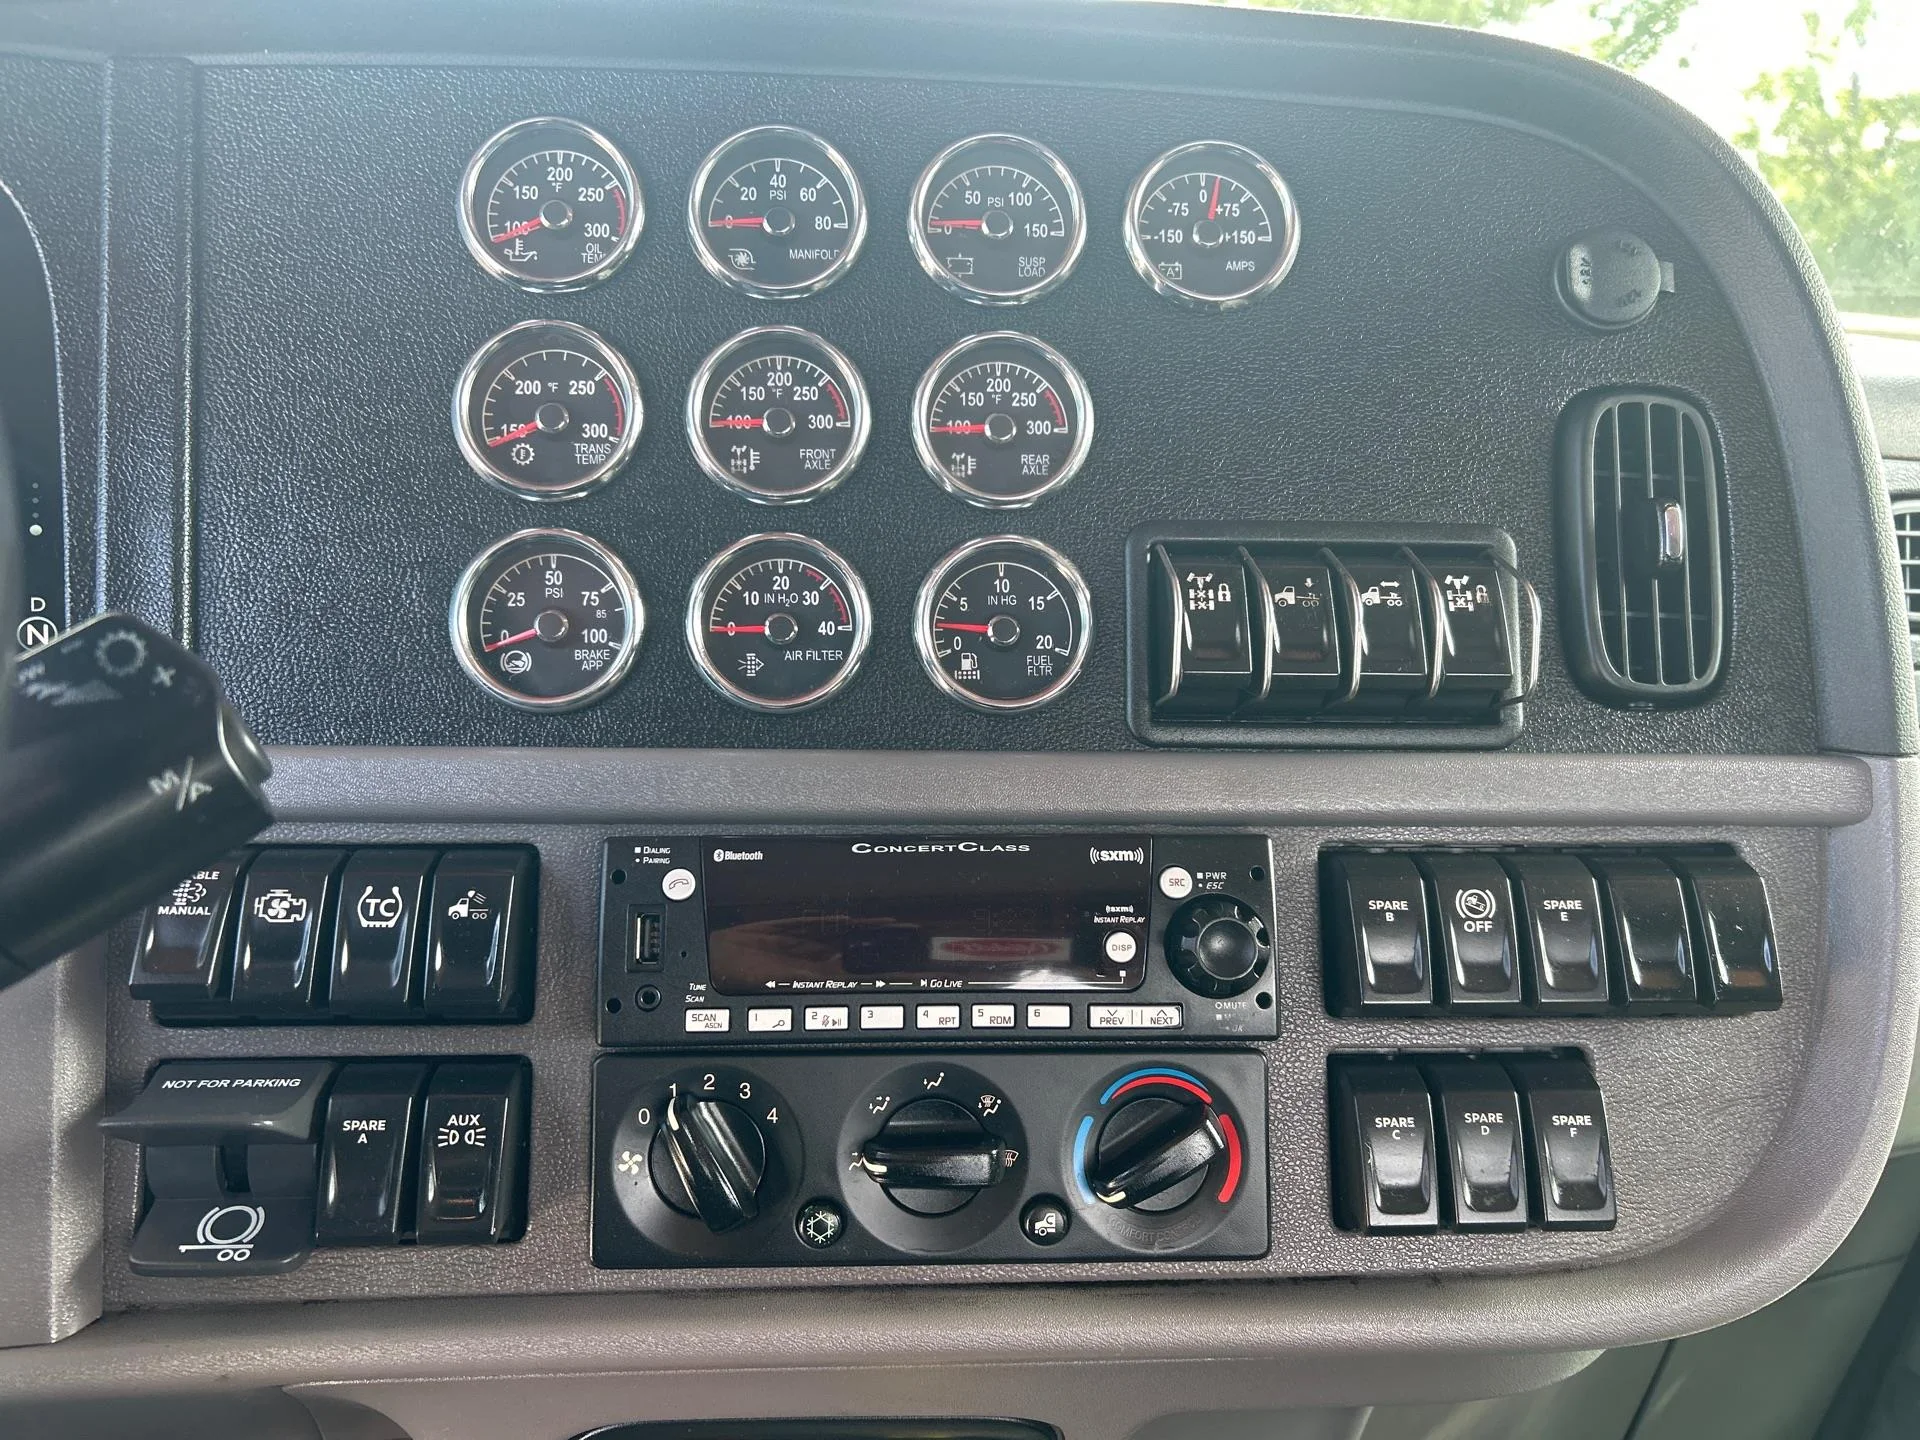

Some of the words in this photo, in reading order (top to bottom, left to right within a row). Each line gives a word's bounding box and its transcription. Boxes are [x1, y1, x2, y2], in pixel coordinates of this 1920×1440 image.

[547, 167, 573, 181] 200
[769, 174, 786, 188] 40
[513, 186, 539, 200] 150
[578, 187, 604, 202] 250
[740, 187, 757, 201] 20
[769, 190, 786, 201] PSI
[799, 187, 817, 202] 60
[964, 191, 981, 205] 50
[1008, 192, 1033, 207] 100
[1199, 189, 1207, 204] 0
[987, 197, 1004, 208] PSI
[1167, 202, 1189, 217] -75
[1216, 203, 1240, 218] +75
[725, 215, 733, 229] 0
[814, 216, 832, 231] 80
[584, 223, 610, 238] 300
[944, 223, 952, 236] 0
[1024, 223, 1049, 238] 150
[1153, 229, 1183, 244] -150
[1225, 230, 1256, 245] +150
[586, 243, 603, 254] OIL
[1018, 256, 1046, 268] SUSP
[1225, 260, 1256, 272] AMPS
[1018, 267, 1046, 278] LOAD
[766, 372, 793, 387] 200
[985, 378, 1012, 394] 200
[514, 380, 541, 396] 200
[569, 380, 596, 396] 250
[740, 386, 765, 402] 150
[793, 386, 819, 402] 250
[959, 392, 985, 408] 150
[1011, 392, 1038, 408] 250
[808, 414, 834, 430] 300
[1026, 420, 1052, 436] 300
[582, 424, 609, 439] 300
[574, 443, 612, 455] TRANS
[799, 449, 837, 461] FRONT
[575, 454, 606, 465] TEMP
[804, 459, 832, 471] AXLE
[1020, 454, 1051, 466] REAR
[1021, 465, 1049, 476] AXLE
[545, 571, 563, 586] 50
[772, 575, 790, 591] 20
[993, 578, 1010, 593] 10
[508, 592, 526, 607] 25
[545, 588, 563, 599] PSI
[580, 592, 600, 607] 75
[742, 590, 760, 606] 10
[764, 594, 775, 604] IN
[802, 590, 820, 606] 30
[987, 595, 998, 606] IN
[1001, 594, 1017, 606] HG
[30, 597, 46, 612] D
[960, 597, 968, 611] 5
[1028, 595, 1045, 611] 15
[596, 609, 607, 619] 85
[727, 621, 736, 636] 0
[818, 620, 836, 636] 40
[26, 623, 49, 647] N
[501, 629, 509, 643] 0
[582, 629, 609, 645] 100
[953, 636, 962, 650] 0
[1035, 635, 1053, 650] 20
[574, 650, 611, 661] BRAKE
[784, 650, 803, 661] AIR
[806, 650, 844, 661] FILTER
[1026, 656, 1053, 666] FUEL
[581, 660, 604, 671] APP
[1027, 666, 1052, 676] FLTR
[725, 851, 764, 862] Bluetooth
[1206, 871, 1228, 881] PWR
[1169, 878, 1186, 888] SRC
[1207, 881, 1225, 891] ESC
[158, 905, 211, 917] MANUAL
[365, 898, 396, 918] TC
[1368, 899, 1409, 911] SPARE
[1543, 899, 1583, 911] SPARE
[1385, 911, 1395, 922] B
[1560, 911, 1569, 921] E
[1463, 920, 1494, 933] OFF
[1112, 943, 1133, 952] DISP
[792, 980, 825, 989] INSTANT
[825, 980, 858, 989] REPLAY
[685, 994, 705, 1003] SCAN
[1223, 1001, 1247, 1010] MUTE
[691, 1013, 717, 1023] SCAN
[811, 1011, 818, 1020] 2
[867, 1010, 874, 1019] 3
[922, 1010, 930, 1019] 4
[976, 1009, 984, 1018] 5
[1033, 1009, 1041, 1018] 6
[938, 1016, 956, 1026] RPT
[989, 1016, 1011, 1026] RDM
[1099, 1016, 1124, 1025] PREV
[1150, 1016, 1174, 1025] NEXT
[161, 1079, 198, 1089] NOT
[198, 1079, 233, 1089] FOR
[233, 1077, 302, 1088] PARKING
[703, 1074, 716, 1091] 2
[669, 1083, 678, 1098] 1
[739, 1082, 752, 1100] 3
[447, 1113, 481, 1126] AUX
[638, 1108, 651, 1126] 0
[766, 1107, 780, 1124] 4
[1463, 1112, 1504, 1124] SPARE
[1551, 1114, 1593, 1126] SPARE
[342, 1118, 387, 1132] SPARE
[1374, 1116, 1415, 1129] SPARE
[1391, 1129, 1401, 1140] C
[1480, 1125, 1490, 1136] D
[1570, 1127, 1578, 1138] F
[357, 1132, 368, 1144] A
